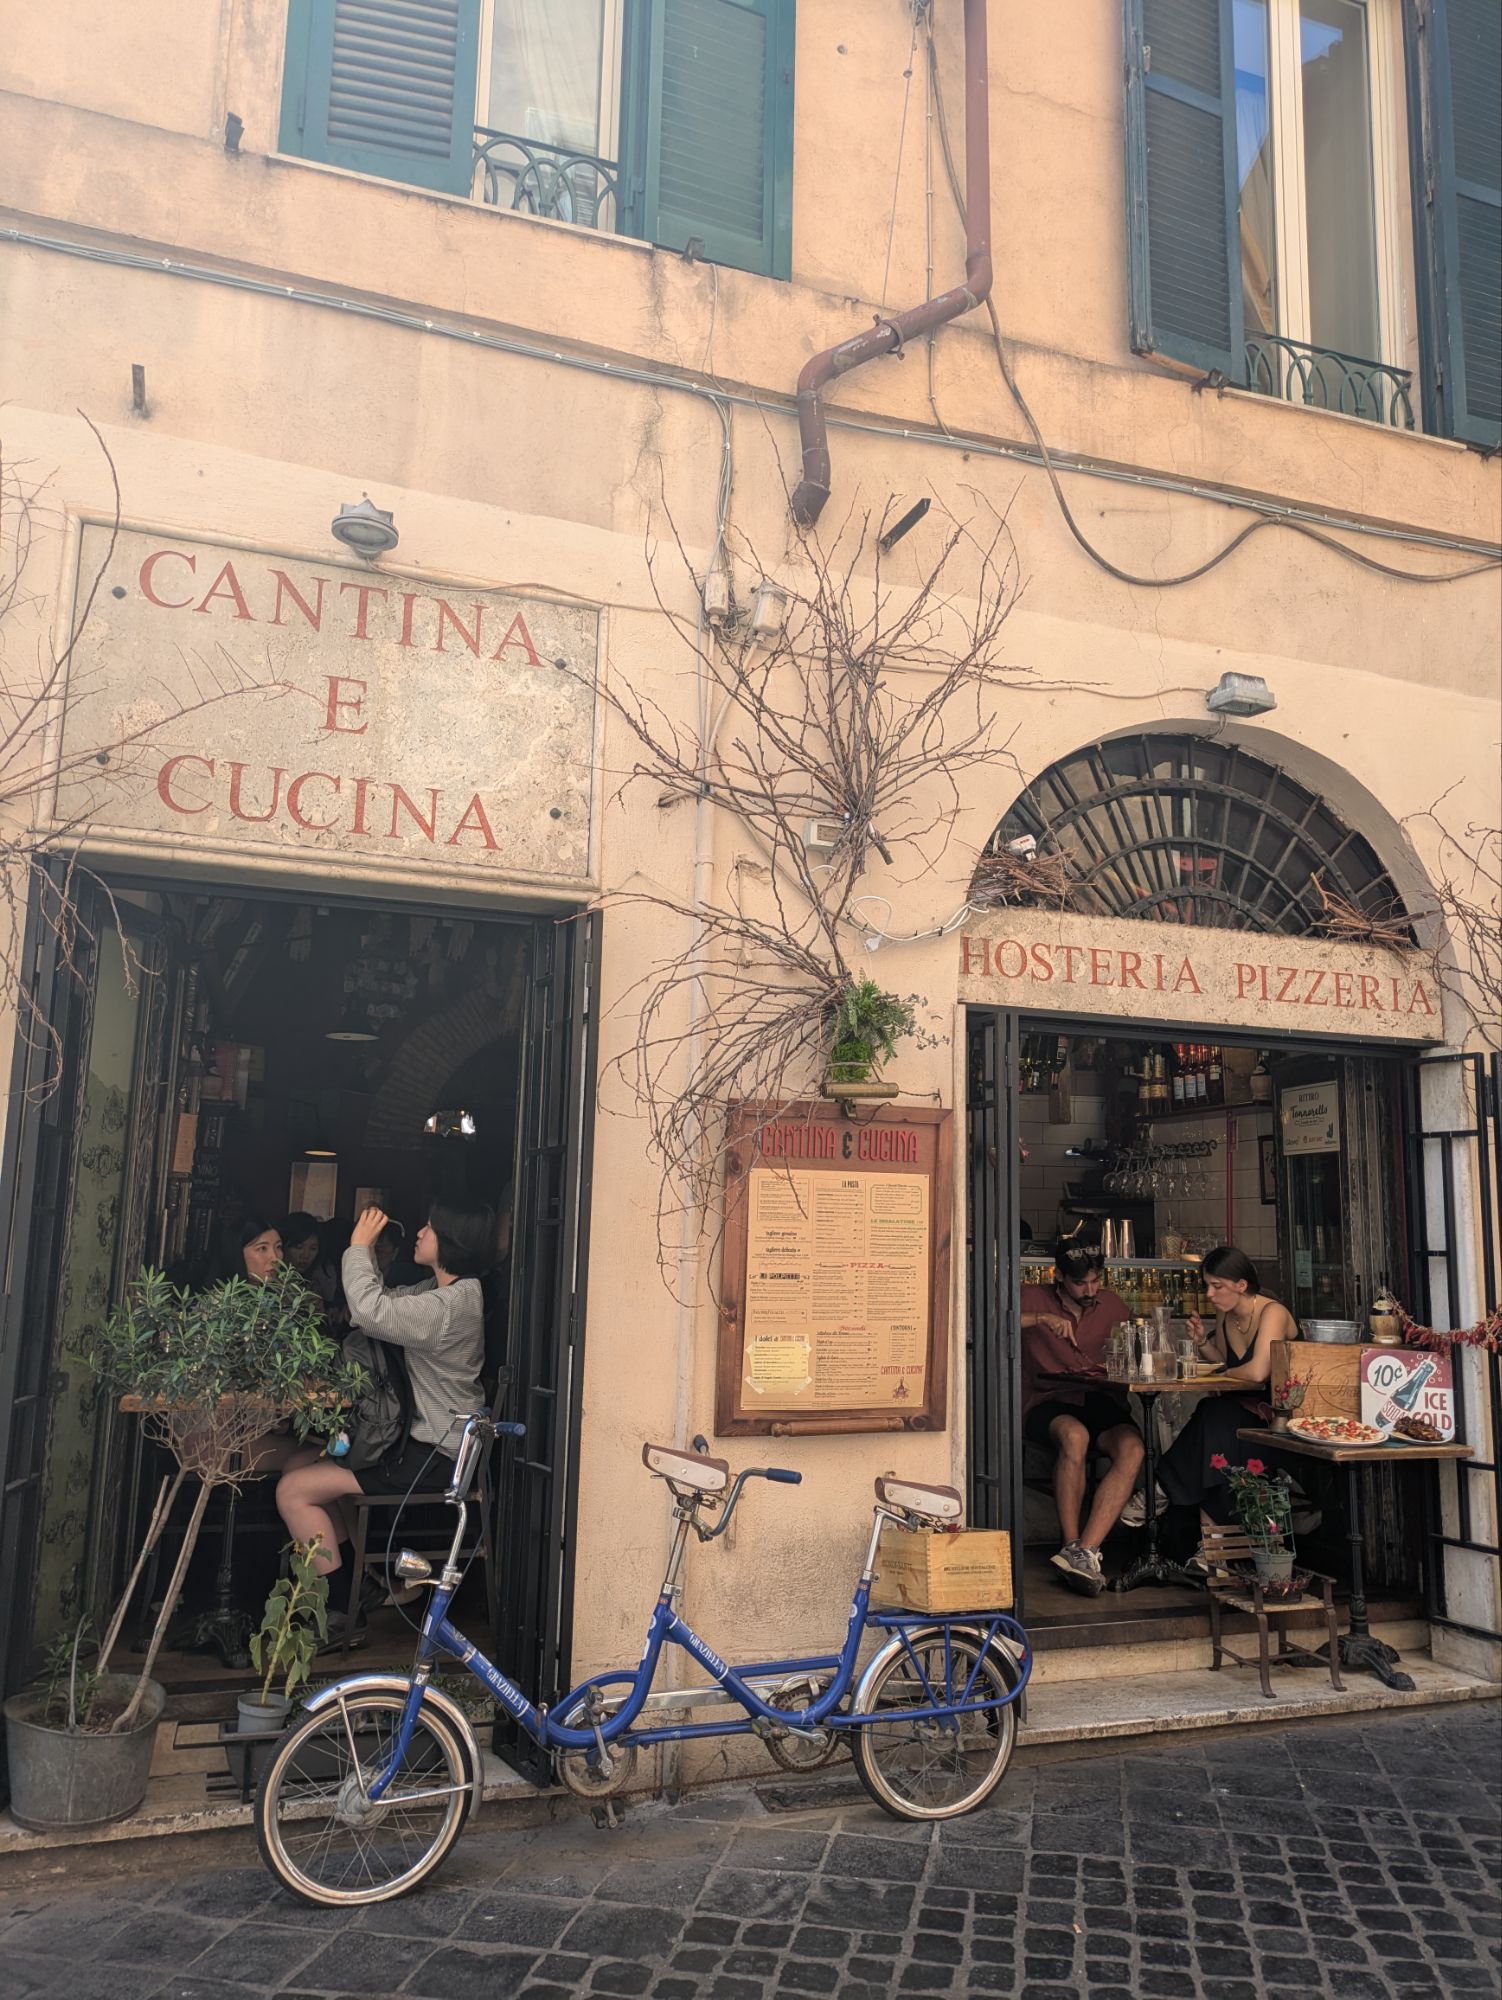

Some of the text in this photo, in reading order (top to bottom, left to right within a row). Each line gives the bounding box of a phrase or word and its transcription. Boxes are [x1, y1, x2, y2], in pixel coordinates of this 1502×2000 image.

[139, 550, 545, 668] CANTINA
[319, 674, 369, 735] E
[157, 754, 502, 851] CUCINA
[960, 936, 1436, 1016] HOSTERIA PIZZERIA
[761, 1125, 837, 1160] CANTINA
[858, 1128, 919, 1163] CUCINA
[1424, 1391, 1448, 1411] ICE
[690, 1633, 725, 1673] GRAZIELLA
[486, 1667, 525, 1711] GRAZIELLA
